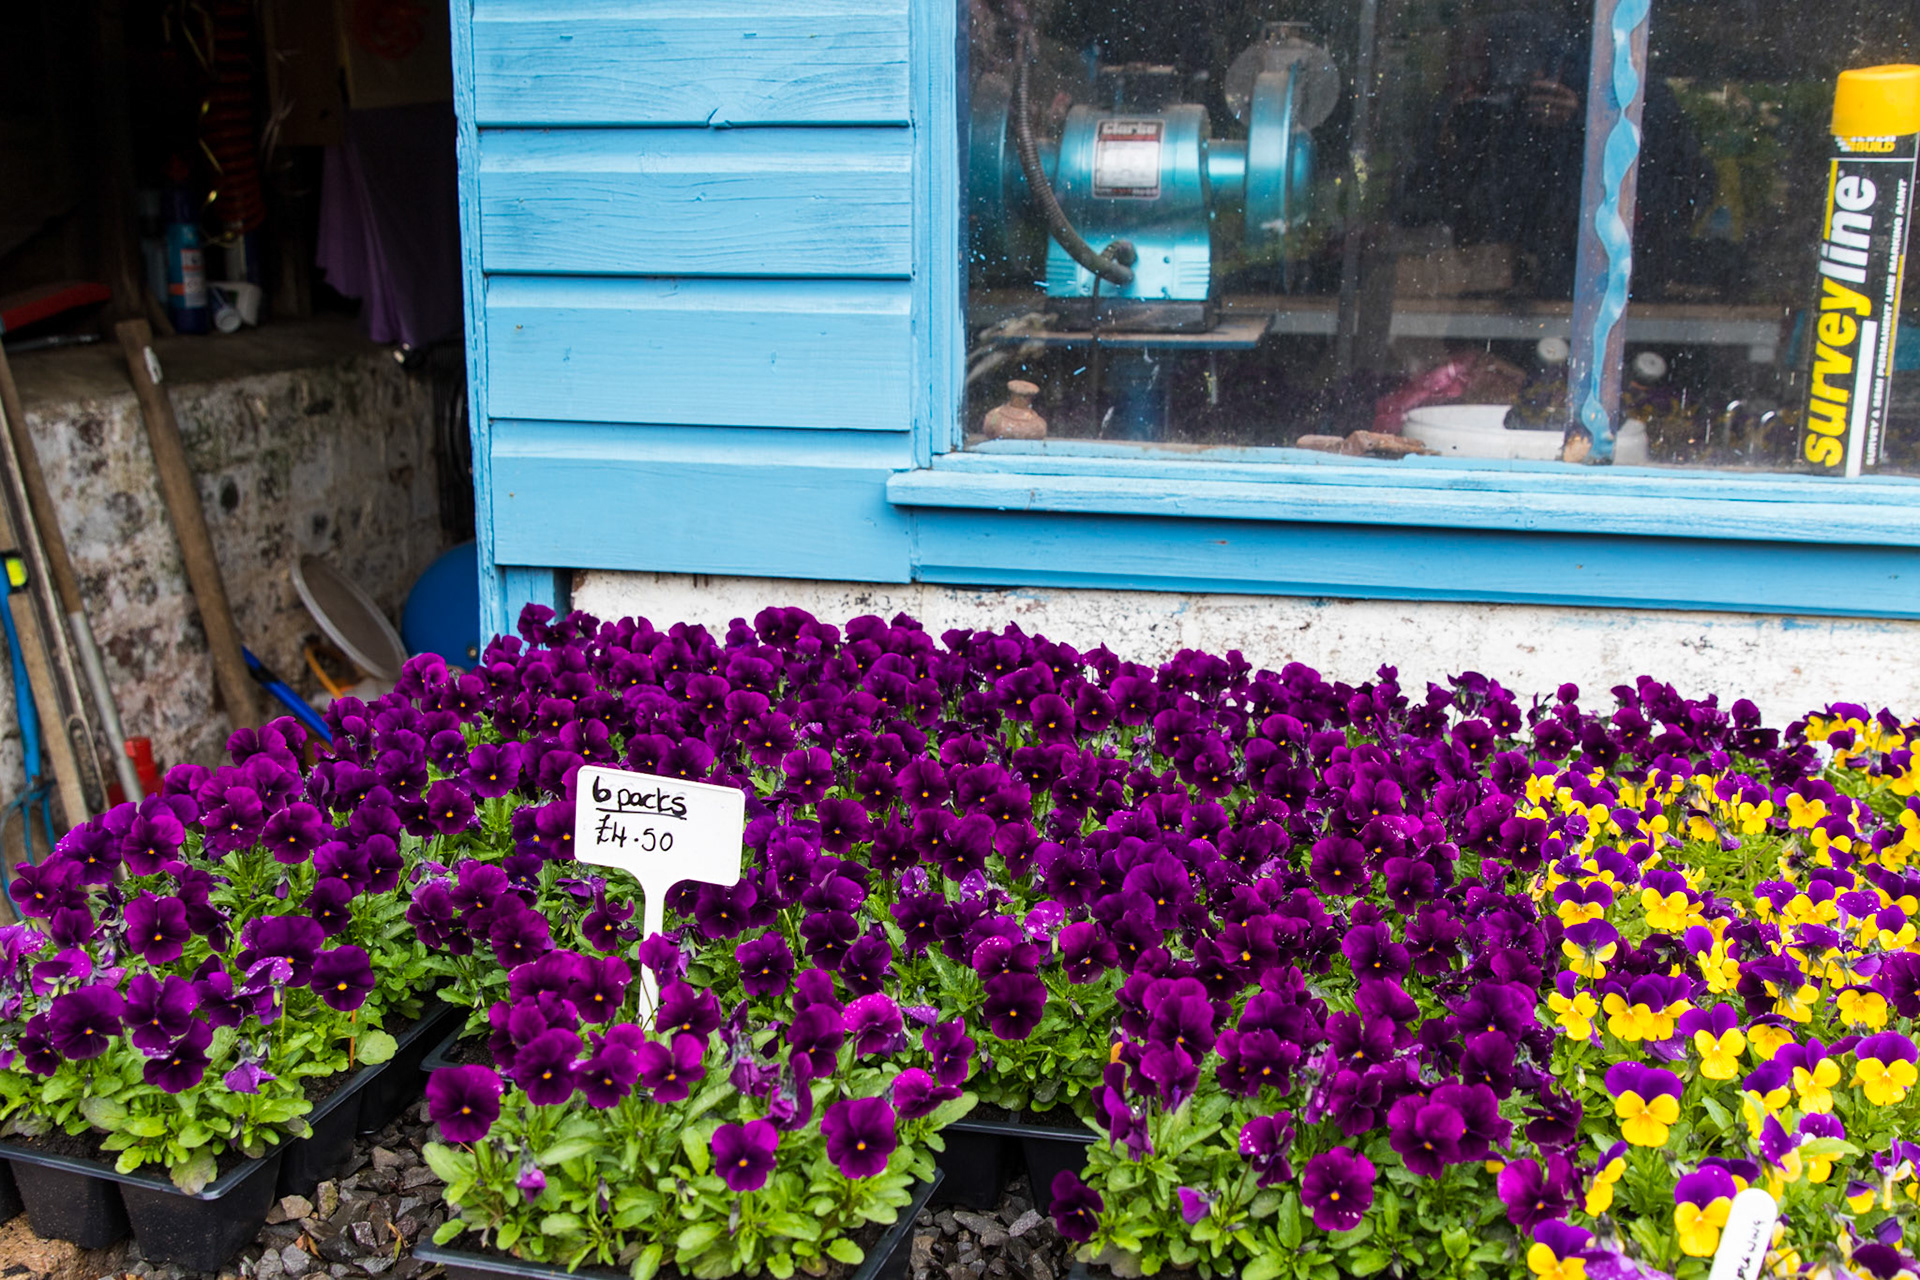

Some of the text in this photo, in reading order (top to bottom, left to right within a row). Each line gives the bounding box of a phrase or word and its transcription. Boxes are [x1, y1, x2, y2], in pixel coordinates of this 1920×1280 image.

[1895, 178, 1907, 215] PAINT
[1888, 217, 1903, 273] MARKING
[1884, 274, 1897, 303] LINE
[1876, 303, 1893, 377] PERMANENT
[1873, 378, 1885, 408] SEMI
[1865, 420, 1880, 466] SURVEY
[592, 776, 687, 816] 6 packs
